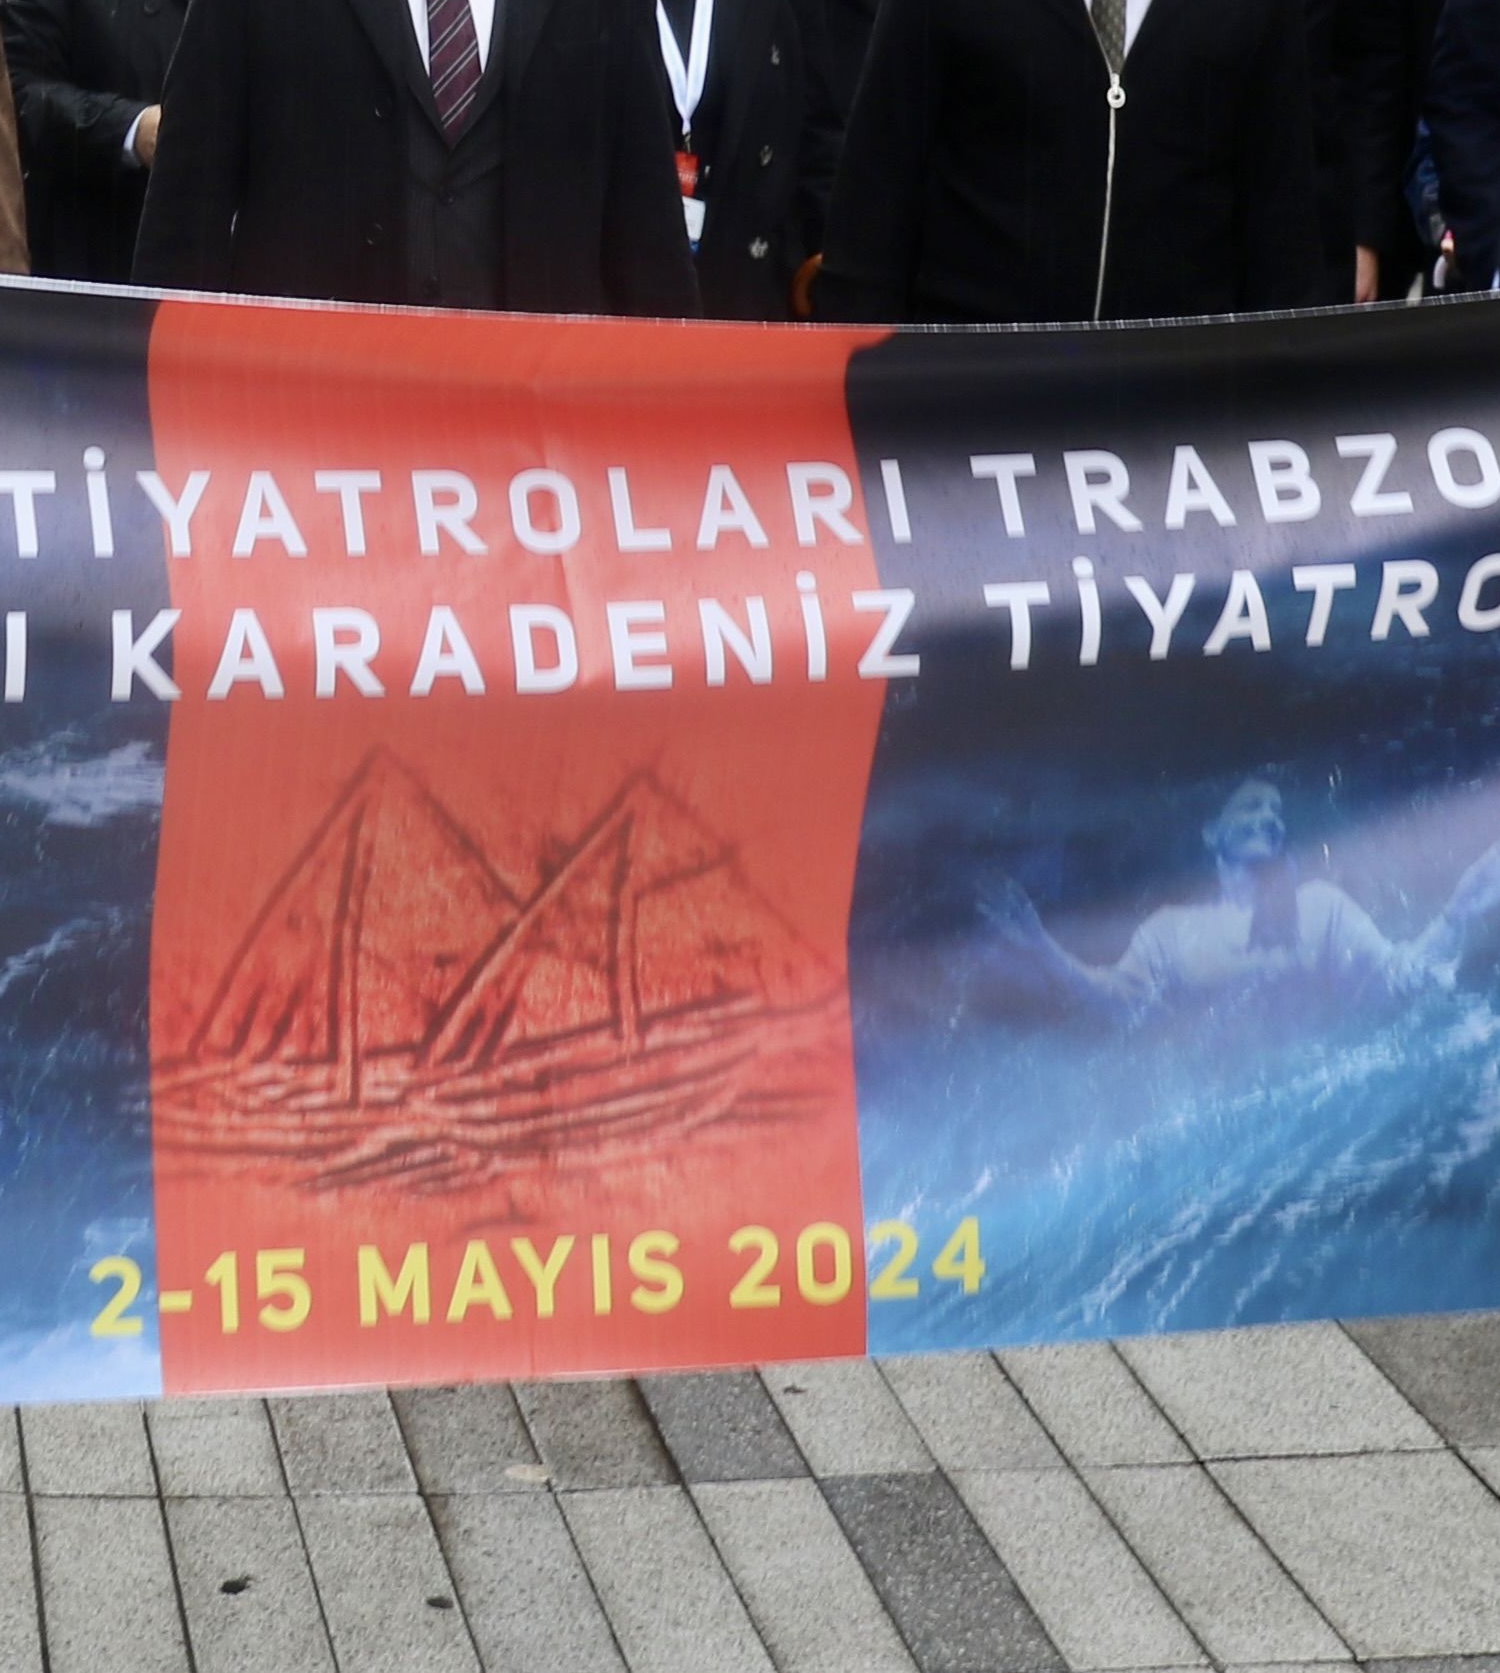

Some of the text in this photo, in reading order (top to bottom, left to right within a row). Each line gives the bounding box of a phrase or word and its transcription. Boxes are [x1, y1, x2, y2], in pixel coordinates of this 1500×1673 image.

[109, 568, 923, 702] KARADENİZ
[88, 1215, 987, 1339] 2-15 MAYIS 2024
